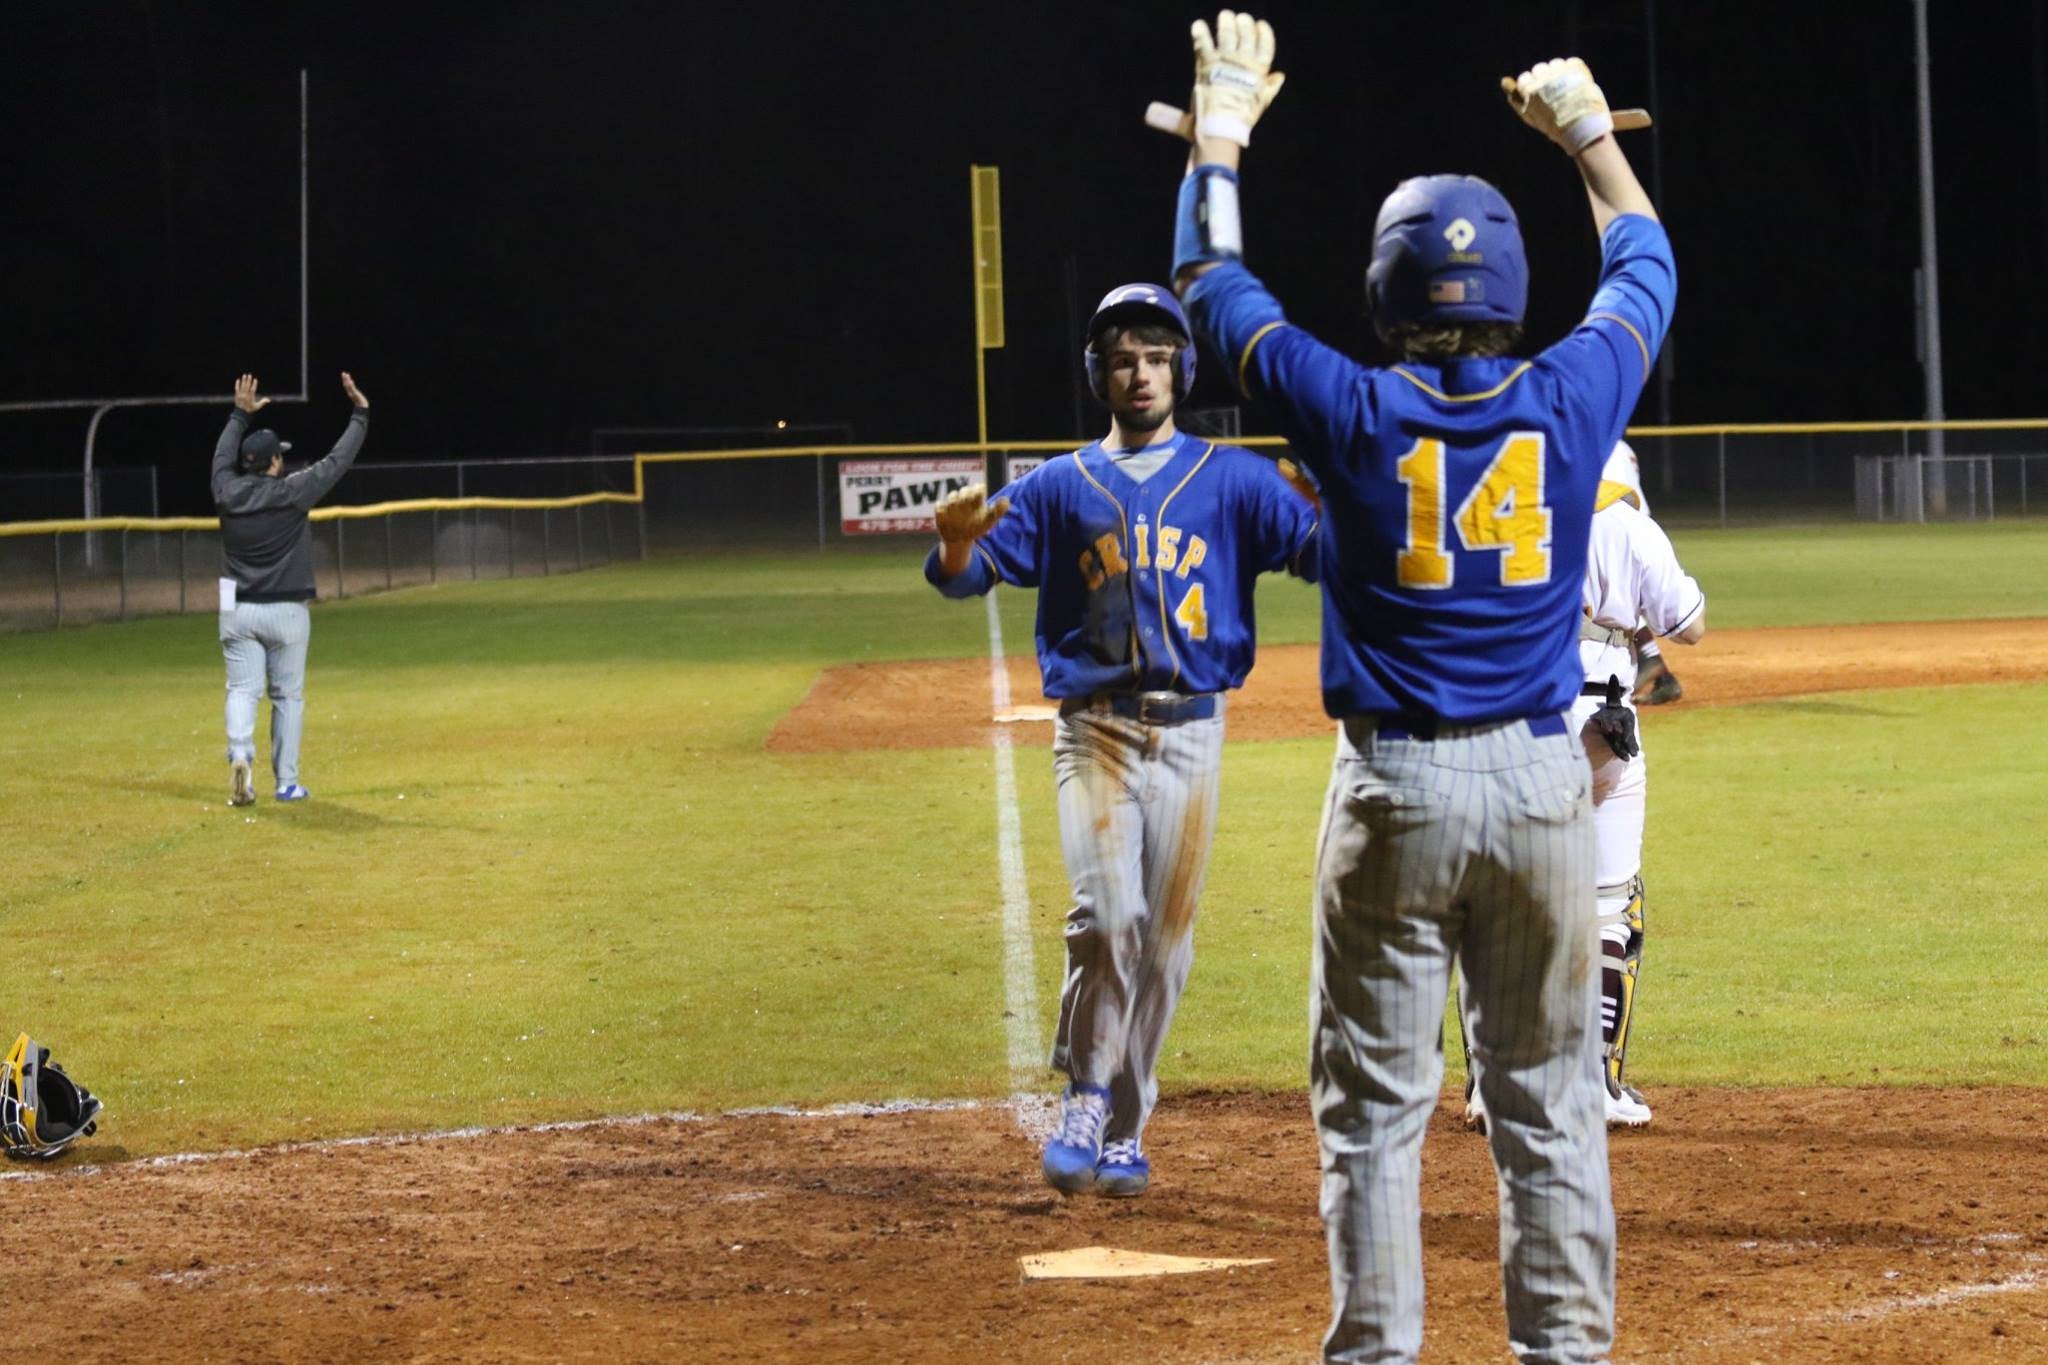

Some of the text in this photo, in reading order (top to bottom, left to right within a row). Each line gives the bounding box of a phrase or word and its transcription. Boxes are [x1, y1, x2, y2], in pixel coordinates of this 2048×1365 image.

[847, 476, 892, 488] PERRY
[1397, 431, 1552, 589] 14
[1079, 523, 1207, 590] CRISP
[1174, 582, 1208, 641] 4
